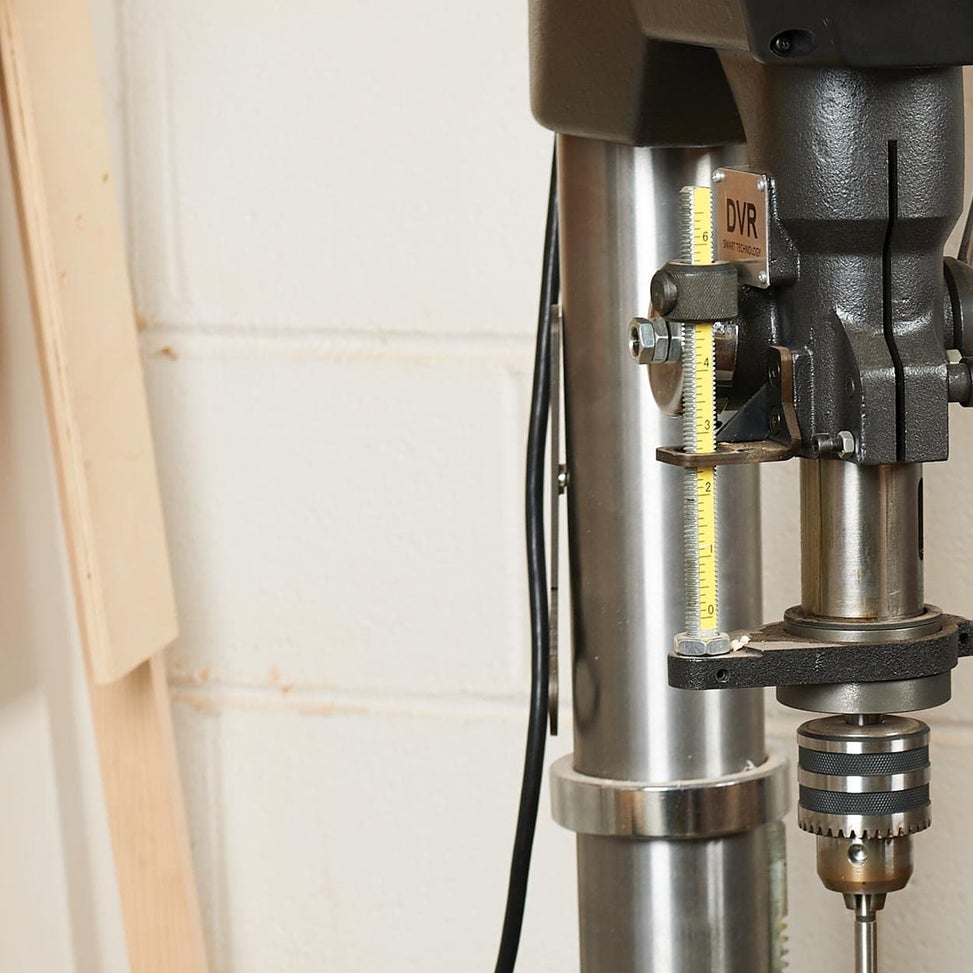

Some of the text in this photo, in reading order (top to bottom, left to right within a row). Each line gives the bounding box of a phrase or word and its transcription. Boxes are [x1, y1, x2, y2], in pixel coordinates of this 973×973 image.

[726, 198, 758, 239] DVR
[702, 231, 709, 242] 6
[703, 357, 710, 368] 4
[704, 420, 711, 430] 3
[705, 482, 712, 492] 2
[707, 604, 715, 615] 0
